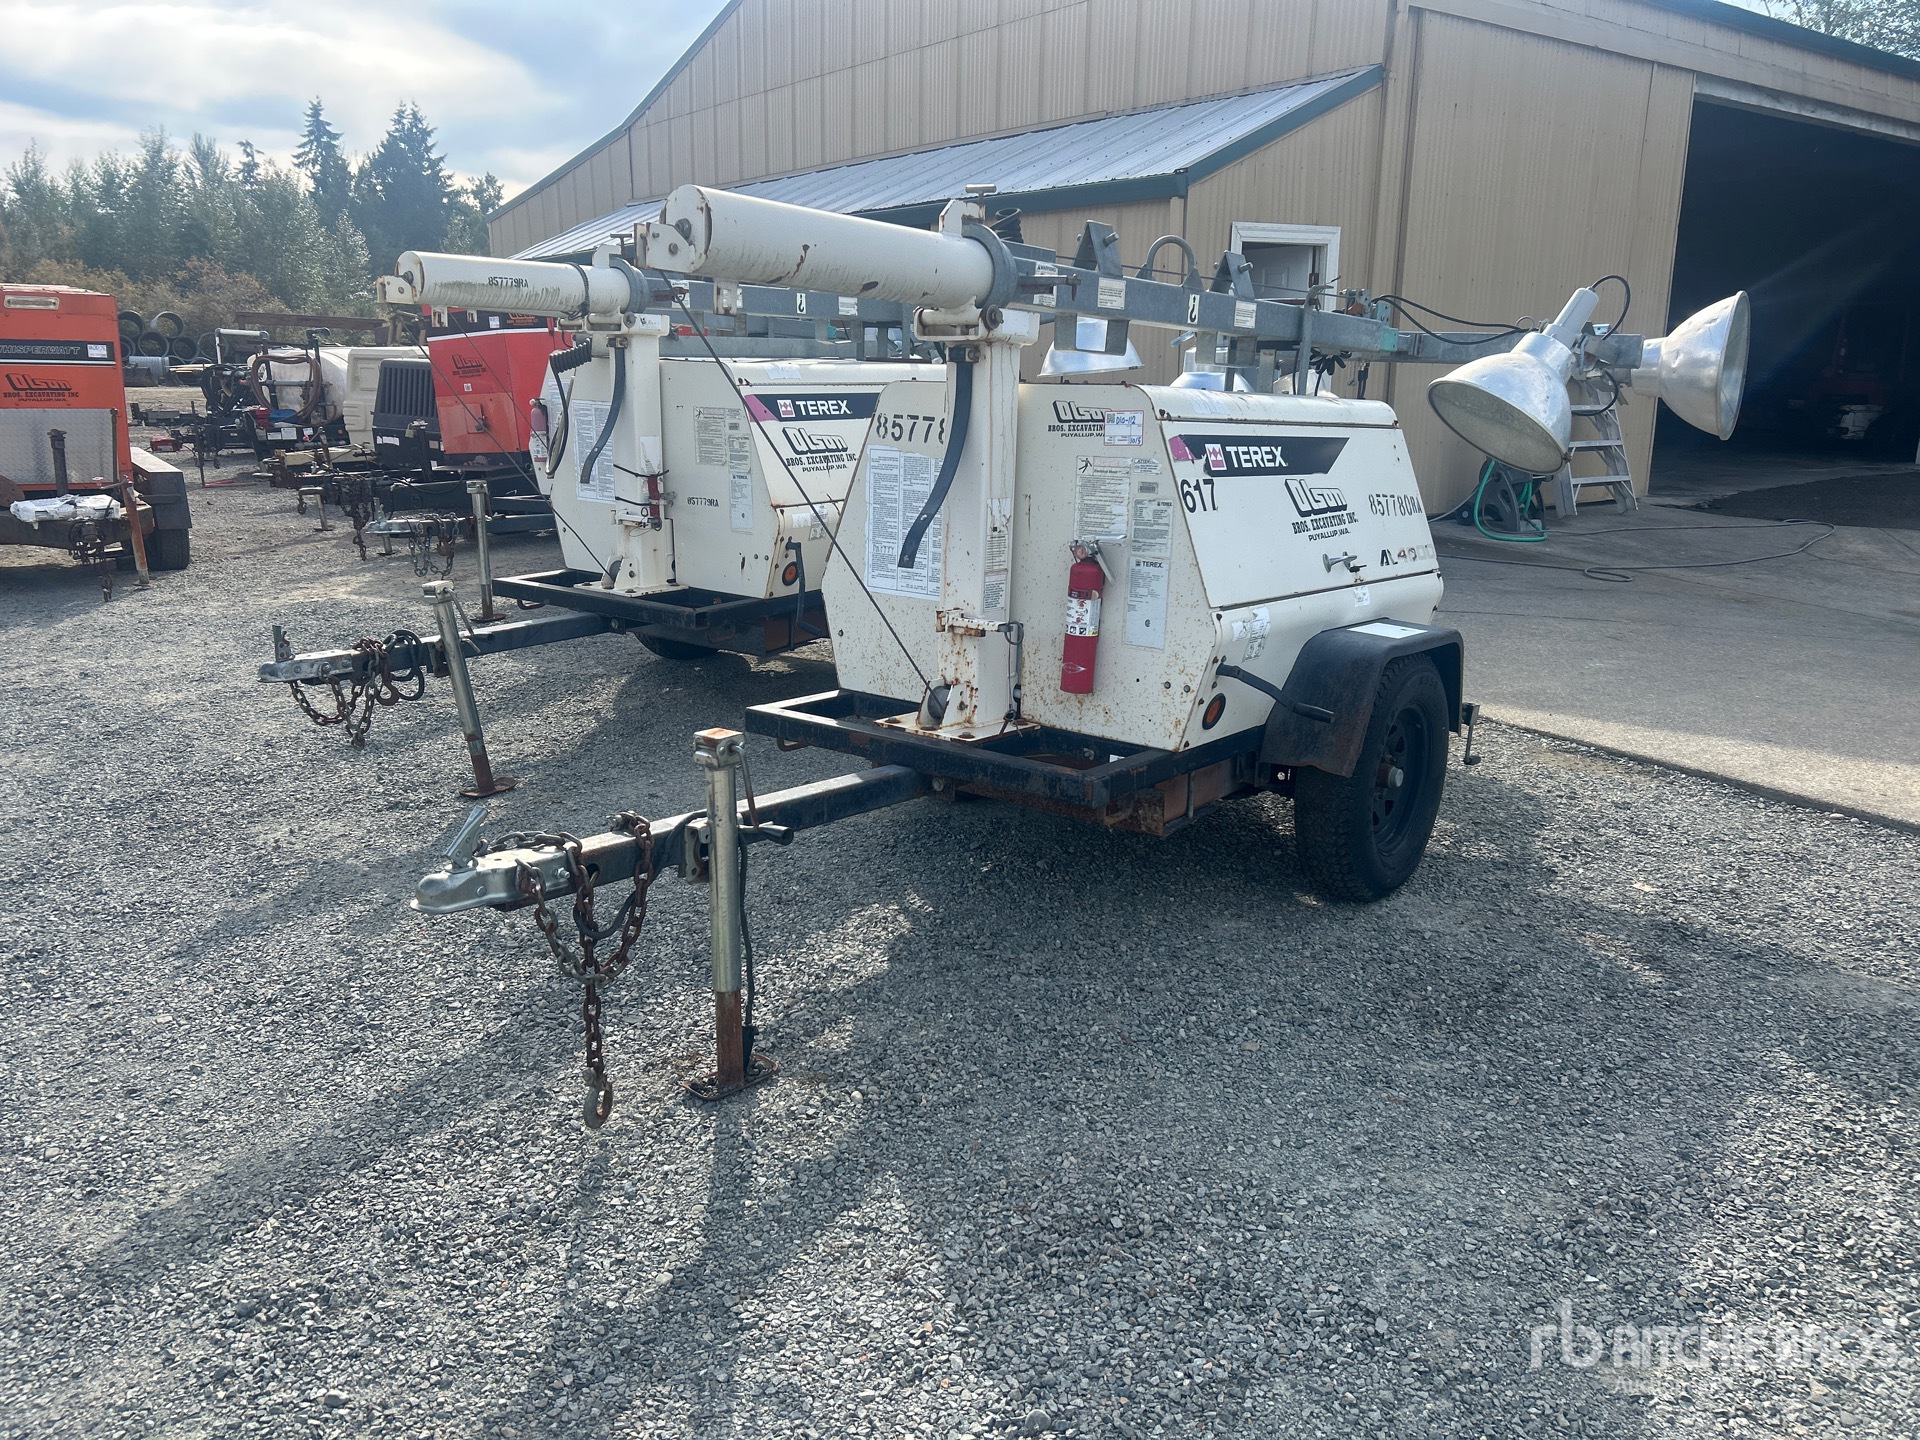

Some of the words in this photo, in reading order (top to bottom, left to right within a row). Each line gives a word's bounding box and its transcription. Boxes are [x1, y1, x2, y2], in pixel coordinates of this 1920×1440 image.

[488, 276, 529, 289] 857779RA
[5, 373, 72, 391] Olson
[796, 400, 851, 416] TEREX
[1047, 424, 1066, 432] BROS.
[1067, 424, 1105, 432] EXCAVATIN
[782, 427, 848, 455] Olson
[785, 456, 806, 467] BROS.
[806, 453, 845, 465] EXCAVATING
[1225, 446, 1288, 468] TEREX
[1180, 478, 1217, 514] 617
[1284, 478, 1348, 518] Olson
[1291, 520, 1311, 535] BROS.
[1310, 513, 1346, 531] EXCAVATING
[1142, 560, 1164, 569] TEREX
